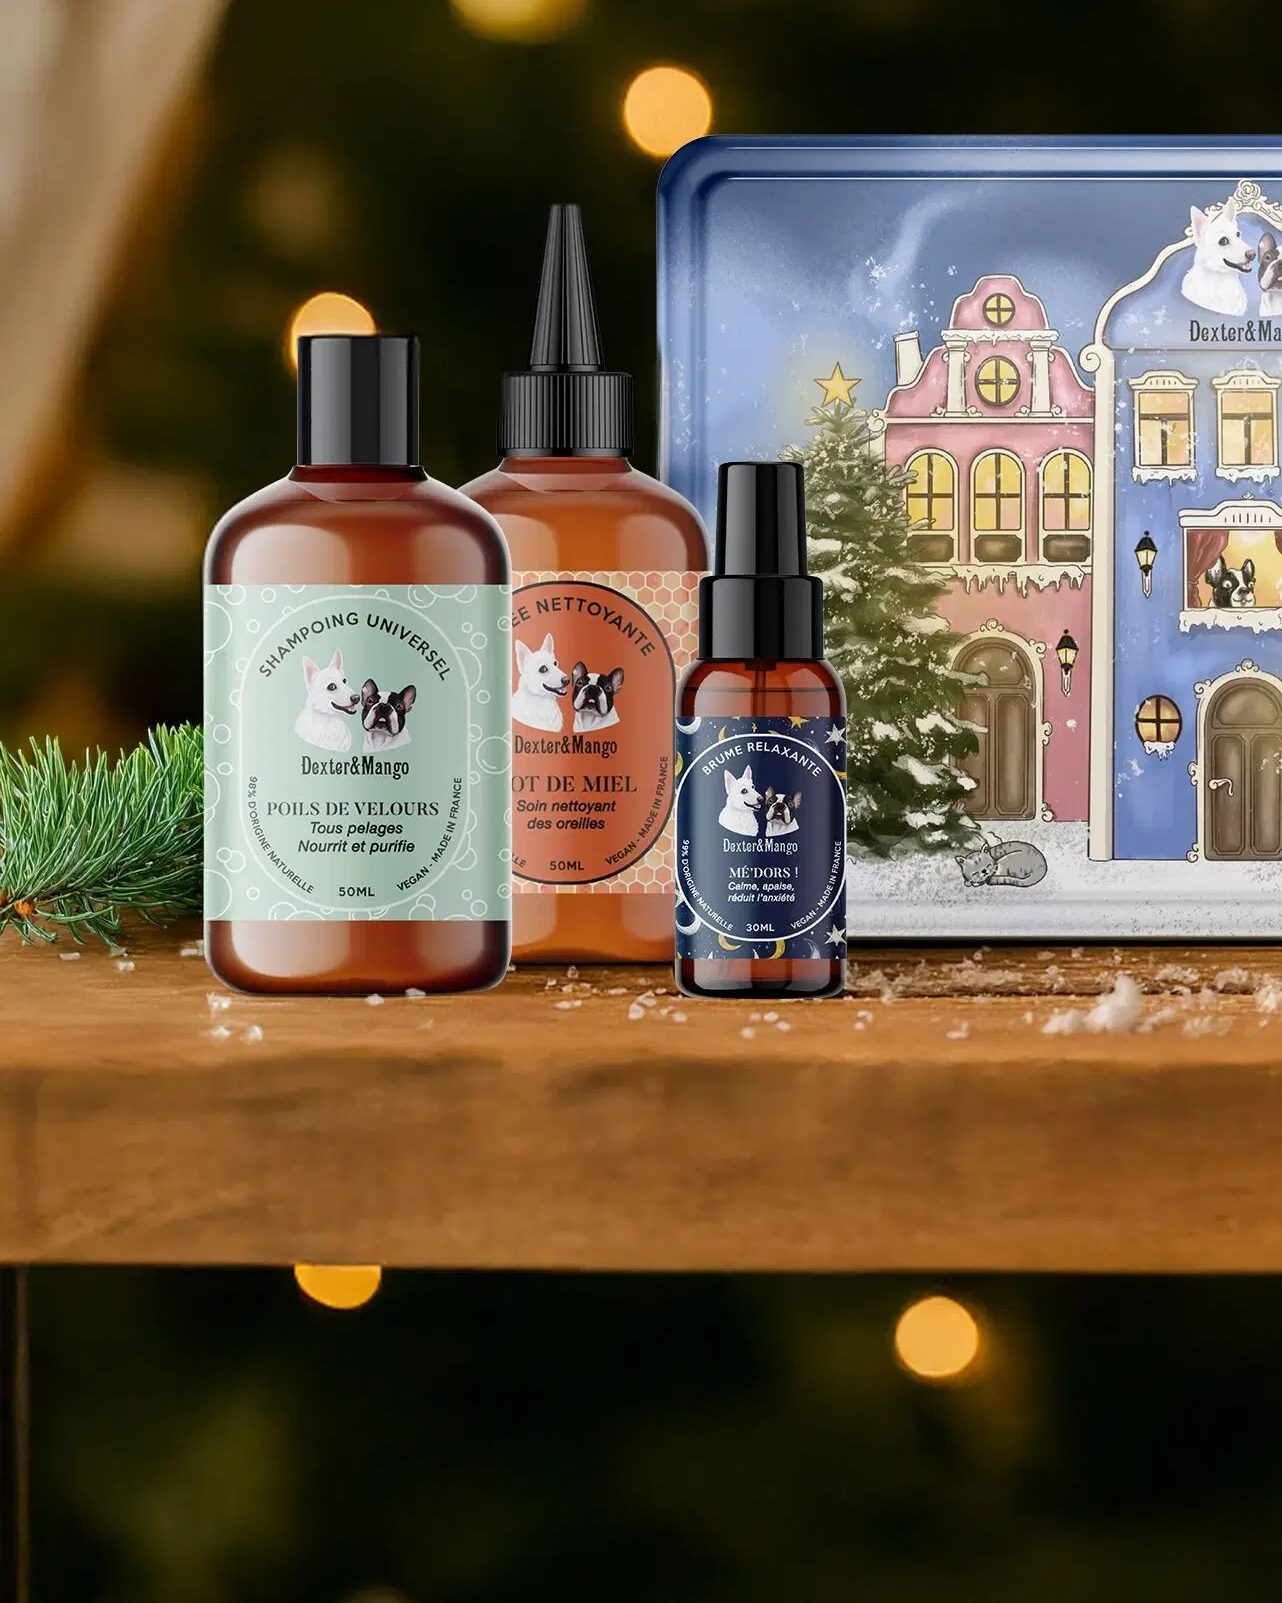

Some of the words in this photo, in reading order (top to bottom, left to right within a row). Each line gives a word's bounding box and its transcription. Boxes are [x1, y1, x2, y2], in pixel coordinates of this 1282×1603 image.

[536, 597, 656, 657] NETTOYANTE
[259, 612, 359, 677] SHAMPOING
[367, 613, 451, 681] UNIVERSEL
[514, 735, 617, 758] Dexter&Mango
[301, 756, 409, 780] Dexter&Mango
[701, 745, 743, 776] BRUME
[747, 741, 822, 777] RELAXANTE
[248, 776, 257, 798] 98%
[546, 776, 574, 792] DE
[582, 775, 637, 792] MIEL
[656, 756, 668, 796] FRANCE
[267, 802, 320, 816] POILS
[326, 802, 349, 816] DE
[354, 802, 439, 816] VELOURS
[449, 777, 462, 820] FRANCE
[516, 800, 547, 812] Soin
[551, 800, 616, 815] nettoyant
[653, 799, 662, 810] IN
[248, 801, 271, 851] D'ORIGINE
[310, 822, 343, 834] Tous
[347, 822, 404, 837] pelages
[446, 821, 457, 833] IN
[527, 817, 551, 830] des
[556, 817, 605, 830] oreilles
[638, 811, 658, 838] MADE
[298, 840, 348, 853] Nourrit
[351, 841, 365, 853] et
[369, 840, 415, 855] purifie
[431, 833, 452, 863] MADE
[605, 841, 637, 866] VEGAN
[723, 838, 798, 855] Dexter&Mango
[831, 841, 842, 874] FRANCE
[267, 850, 315, 894] NATURELLE
[550, 861, 584, 871] 50ML
[396, 866, 430, 892] VEGAN
[728, 882, 760, 892] Calme,
[762, 882, 795, 892] apaise,
[829, 875, 837, 885] IN
[338, 887, 375, 897] 50ML
[681, 859, 700, 898] D'ORIGINE
[697, 897, 734, 931] NATURELLE
[728, 893, 755, 902] réduit
[817, 884, 833, 908] MADE
[746, 923, 775, 931] 30ML
[790, 909, 816, 929] VEGAN
